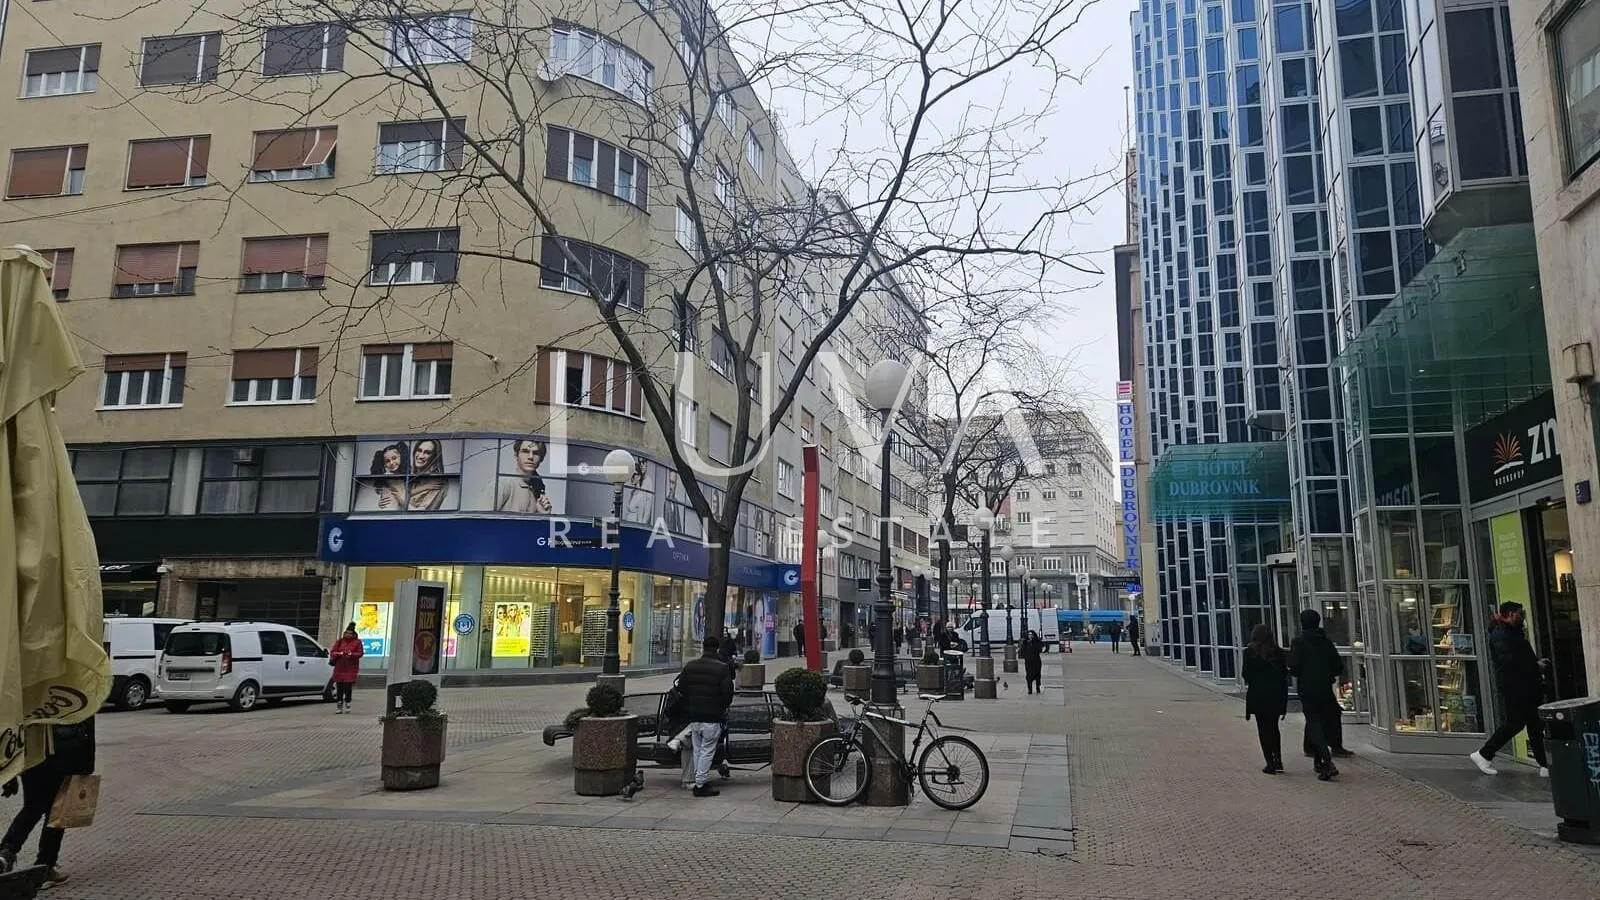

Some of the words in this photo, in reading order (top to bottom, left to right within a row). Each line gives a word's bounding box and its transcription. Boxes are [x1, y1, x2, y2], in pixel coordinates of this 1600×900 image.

[1120, 405, 1133, 460] HOTEL
[1198, 461, 1250, 476] HOTEL
[1169, 480, 1260, 496] DUBROVNIK
[1121, 467, 1138, 568] DUBROVNIK
